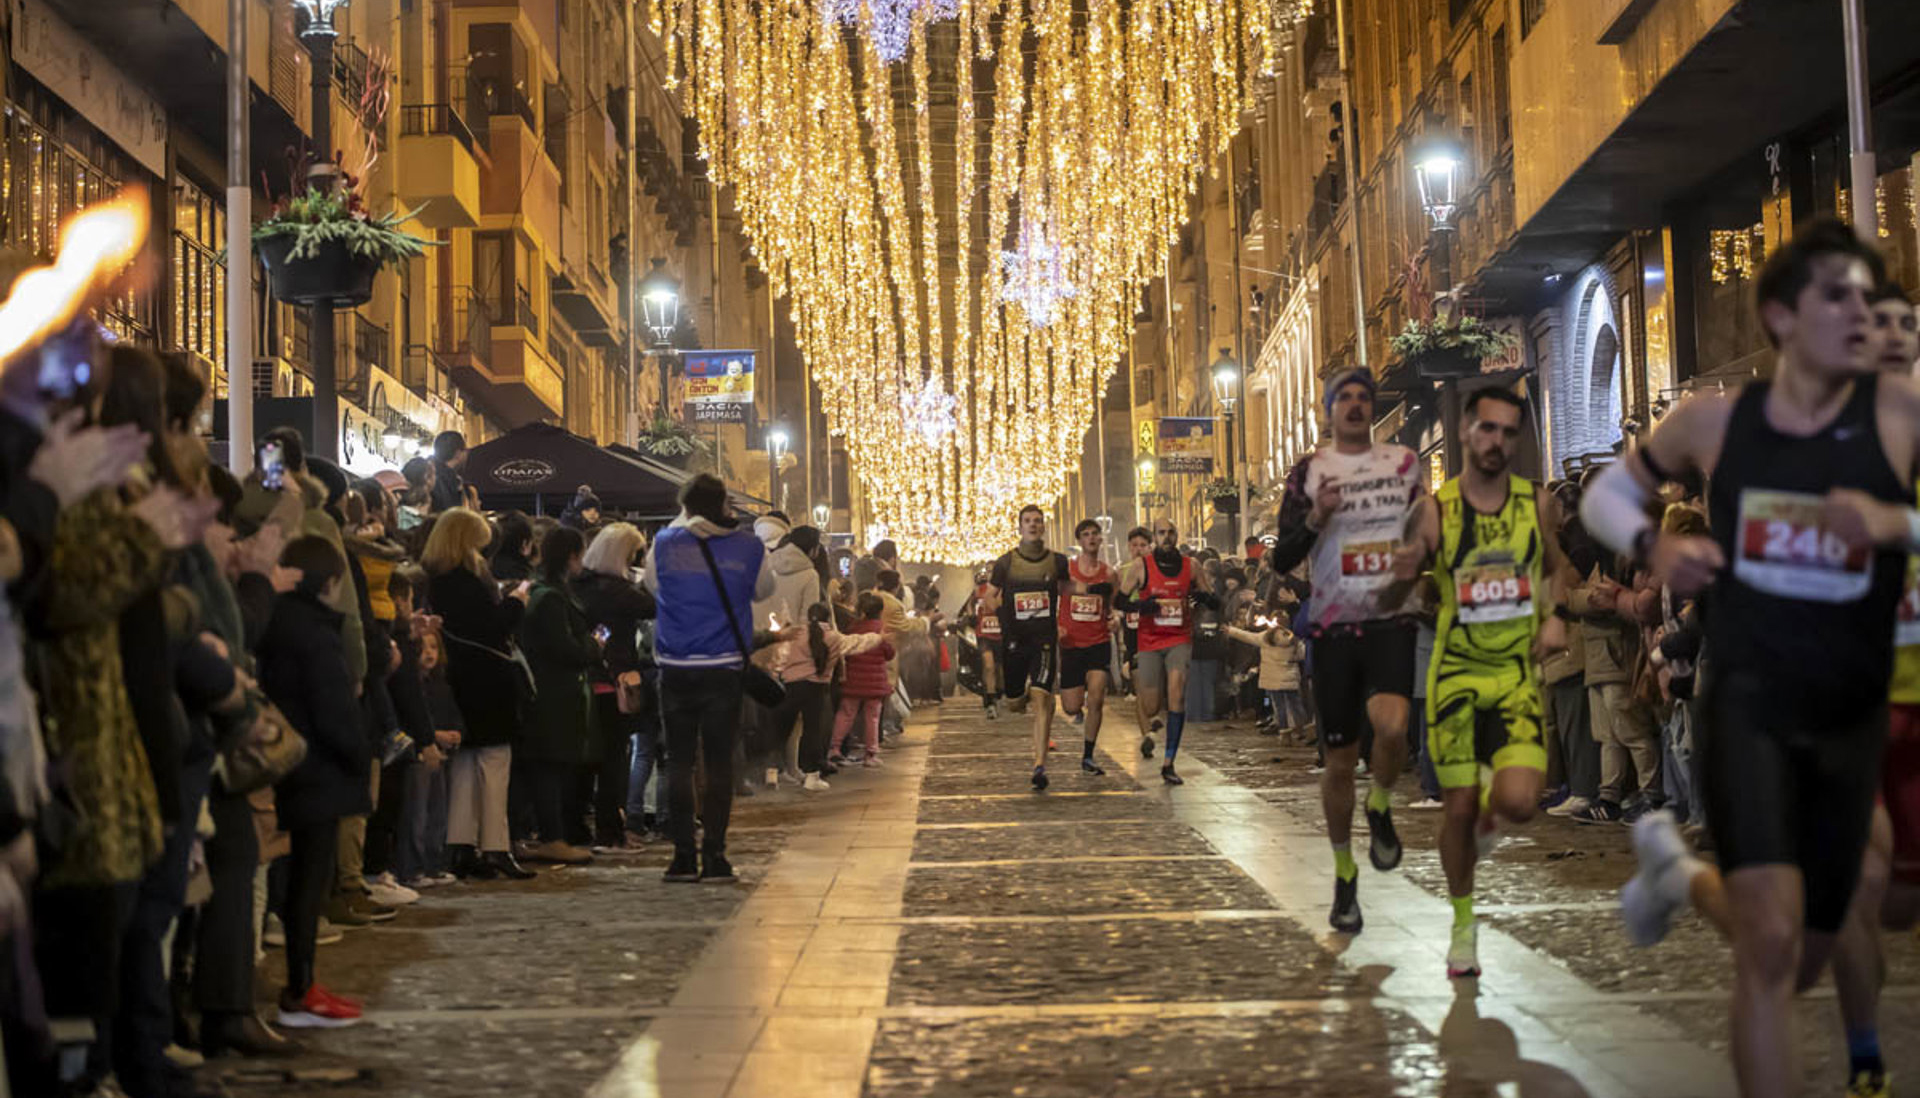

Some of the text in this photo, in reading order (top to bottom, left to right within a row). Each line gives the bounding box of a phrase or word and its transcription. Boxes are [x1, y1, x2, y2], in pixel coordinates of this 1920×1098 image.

[695, 402, 742, 411] DACIA
[1353, 552, 1393, 573] 131
[1471, 577, 1519, 603] 605
